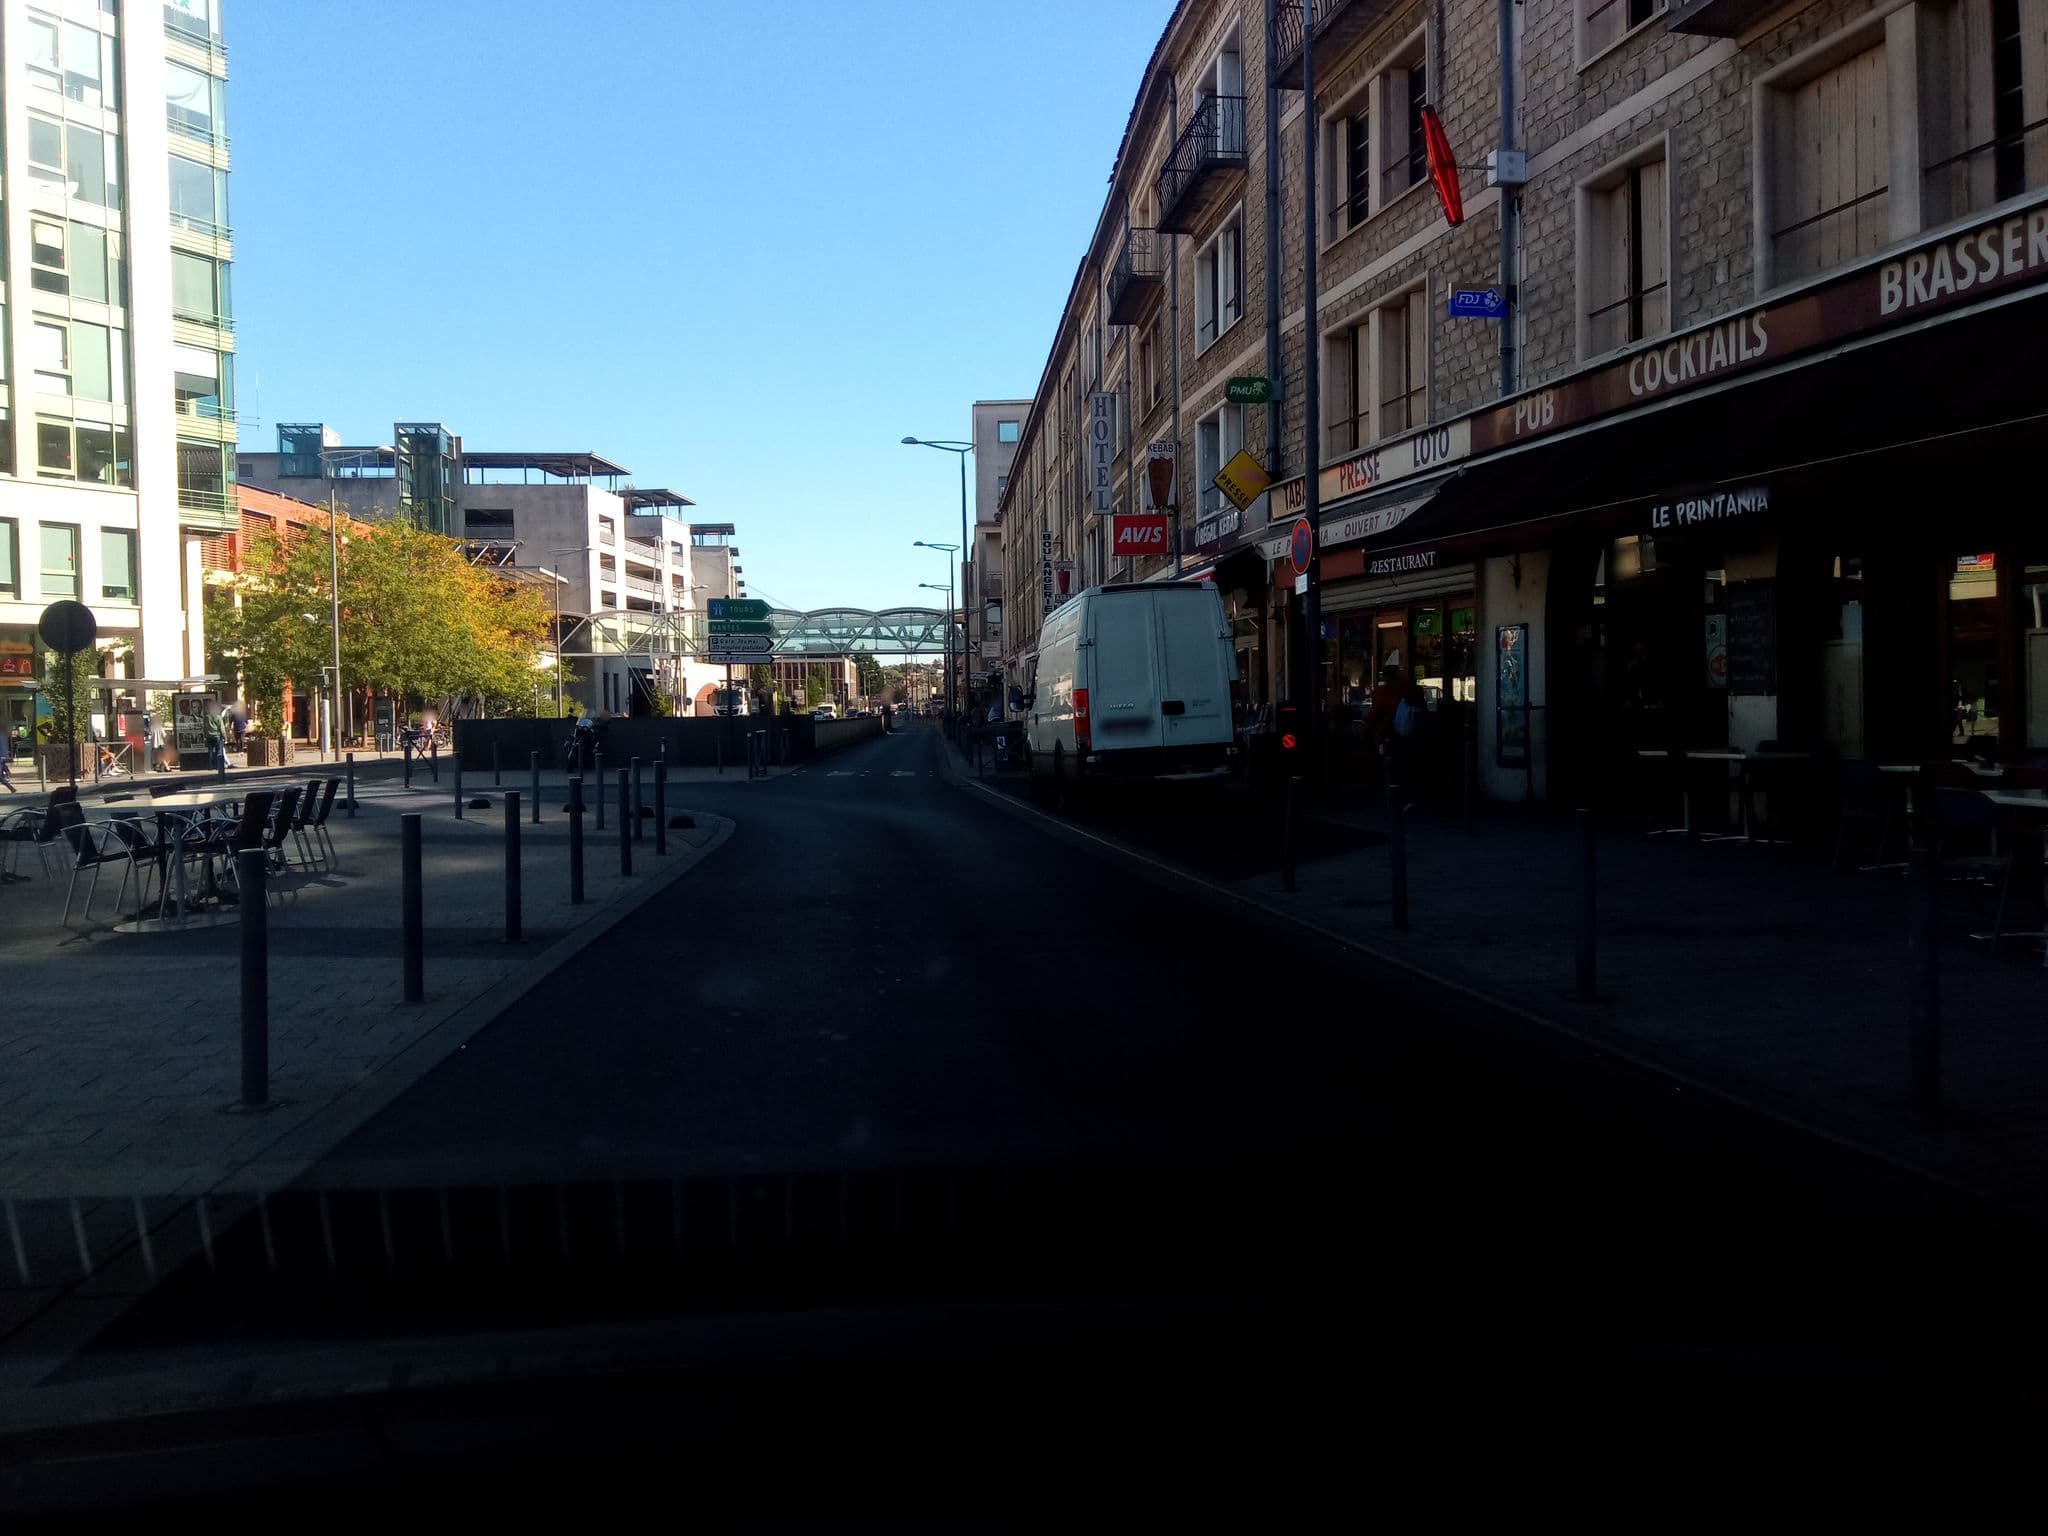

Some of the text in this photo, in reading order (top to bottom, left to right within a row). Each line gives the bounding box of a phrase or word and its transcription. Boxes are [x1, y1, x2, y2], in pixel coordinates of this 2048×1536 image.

[1880, 208, 2048, 316] BRASSER
[1458, 294, 1480, 304] FDJ
[1628, 311, 1768, 396] COCKTAILS
[1230, 386, 1252, 395] PMU
[1515, 393, 1555, 435] PUB
[1094, 397, 1109, 510] HOTEL
[1147, 444, 1174, 453] KEBAB
[1340, 450, 1380, 492] PRESSE
[1412, 425, 1450, 468] LOTO
[1219, 474, 1250, 505] PRESSE
[1344, 515, 1380, 537] OUVERT
[1652, 506, 1670, 528] LE
[1118, 527, 1163, 543] AVIS
[1272, 542, 1281, 555] LE
[1043, 534, 1052, 612] BOULANGERIE
[1370, 551, 1436, 574] RESTAURANT
